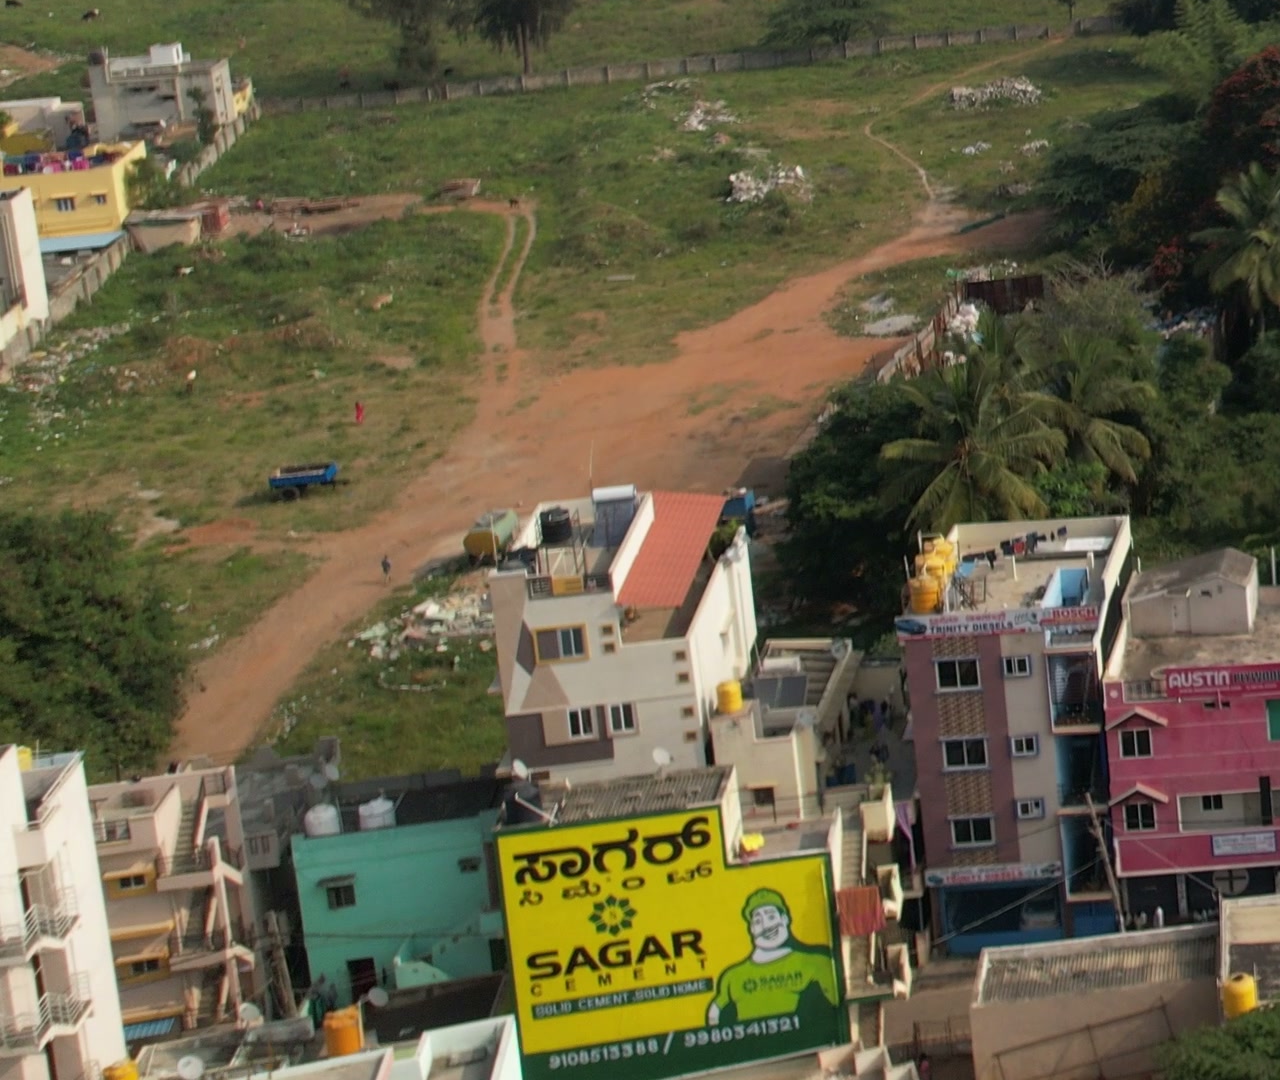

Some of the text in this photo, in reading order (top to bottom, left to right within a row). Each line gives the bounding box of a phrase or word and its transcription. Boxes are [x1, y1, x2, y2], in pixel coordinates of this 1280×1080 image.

[929, 621, 1014, 634] TRINITY DIESELS
[1052, 608, 1096, 620] BOSCH
[1168, 670, 1230, 689] AUSTIN
[513, 816, 711, 886] ಸಾಗರ್
[527, 929, 705, 981] SAGAR
[530, 958, 707, 998] CEMENT
[535, 1000, 572, 1018] SOLID
[578, 993, 629, 1011] CEMENT
[673, 980, 708, 995] HOME
